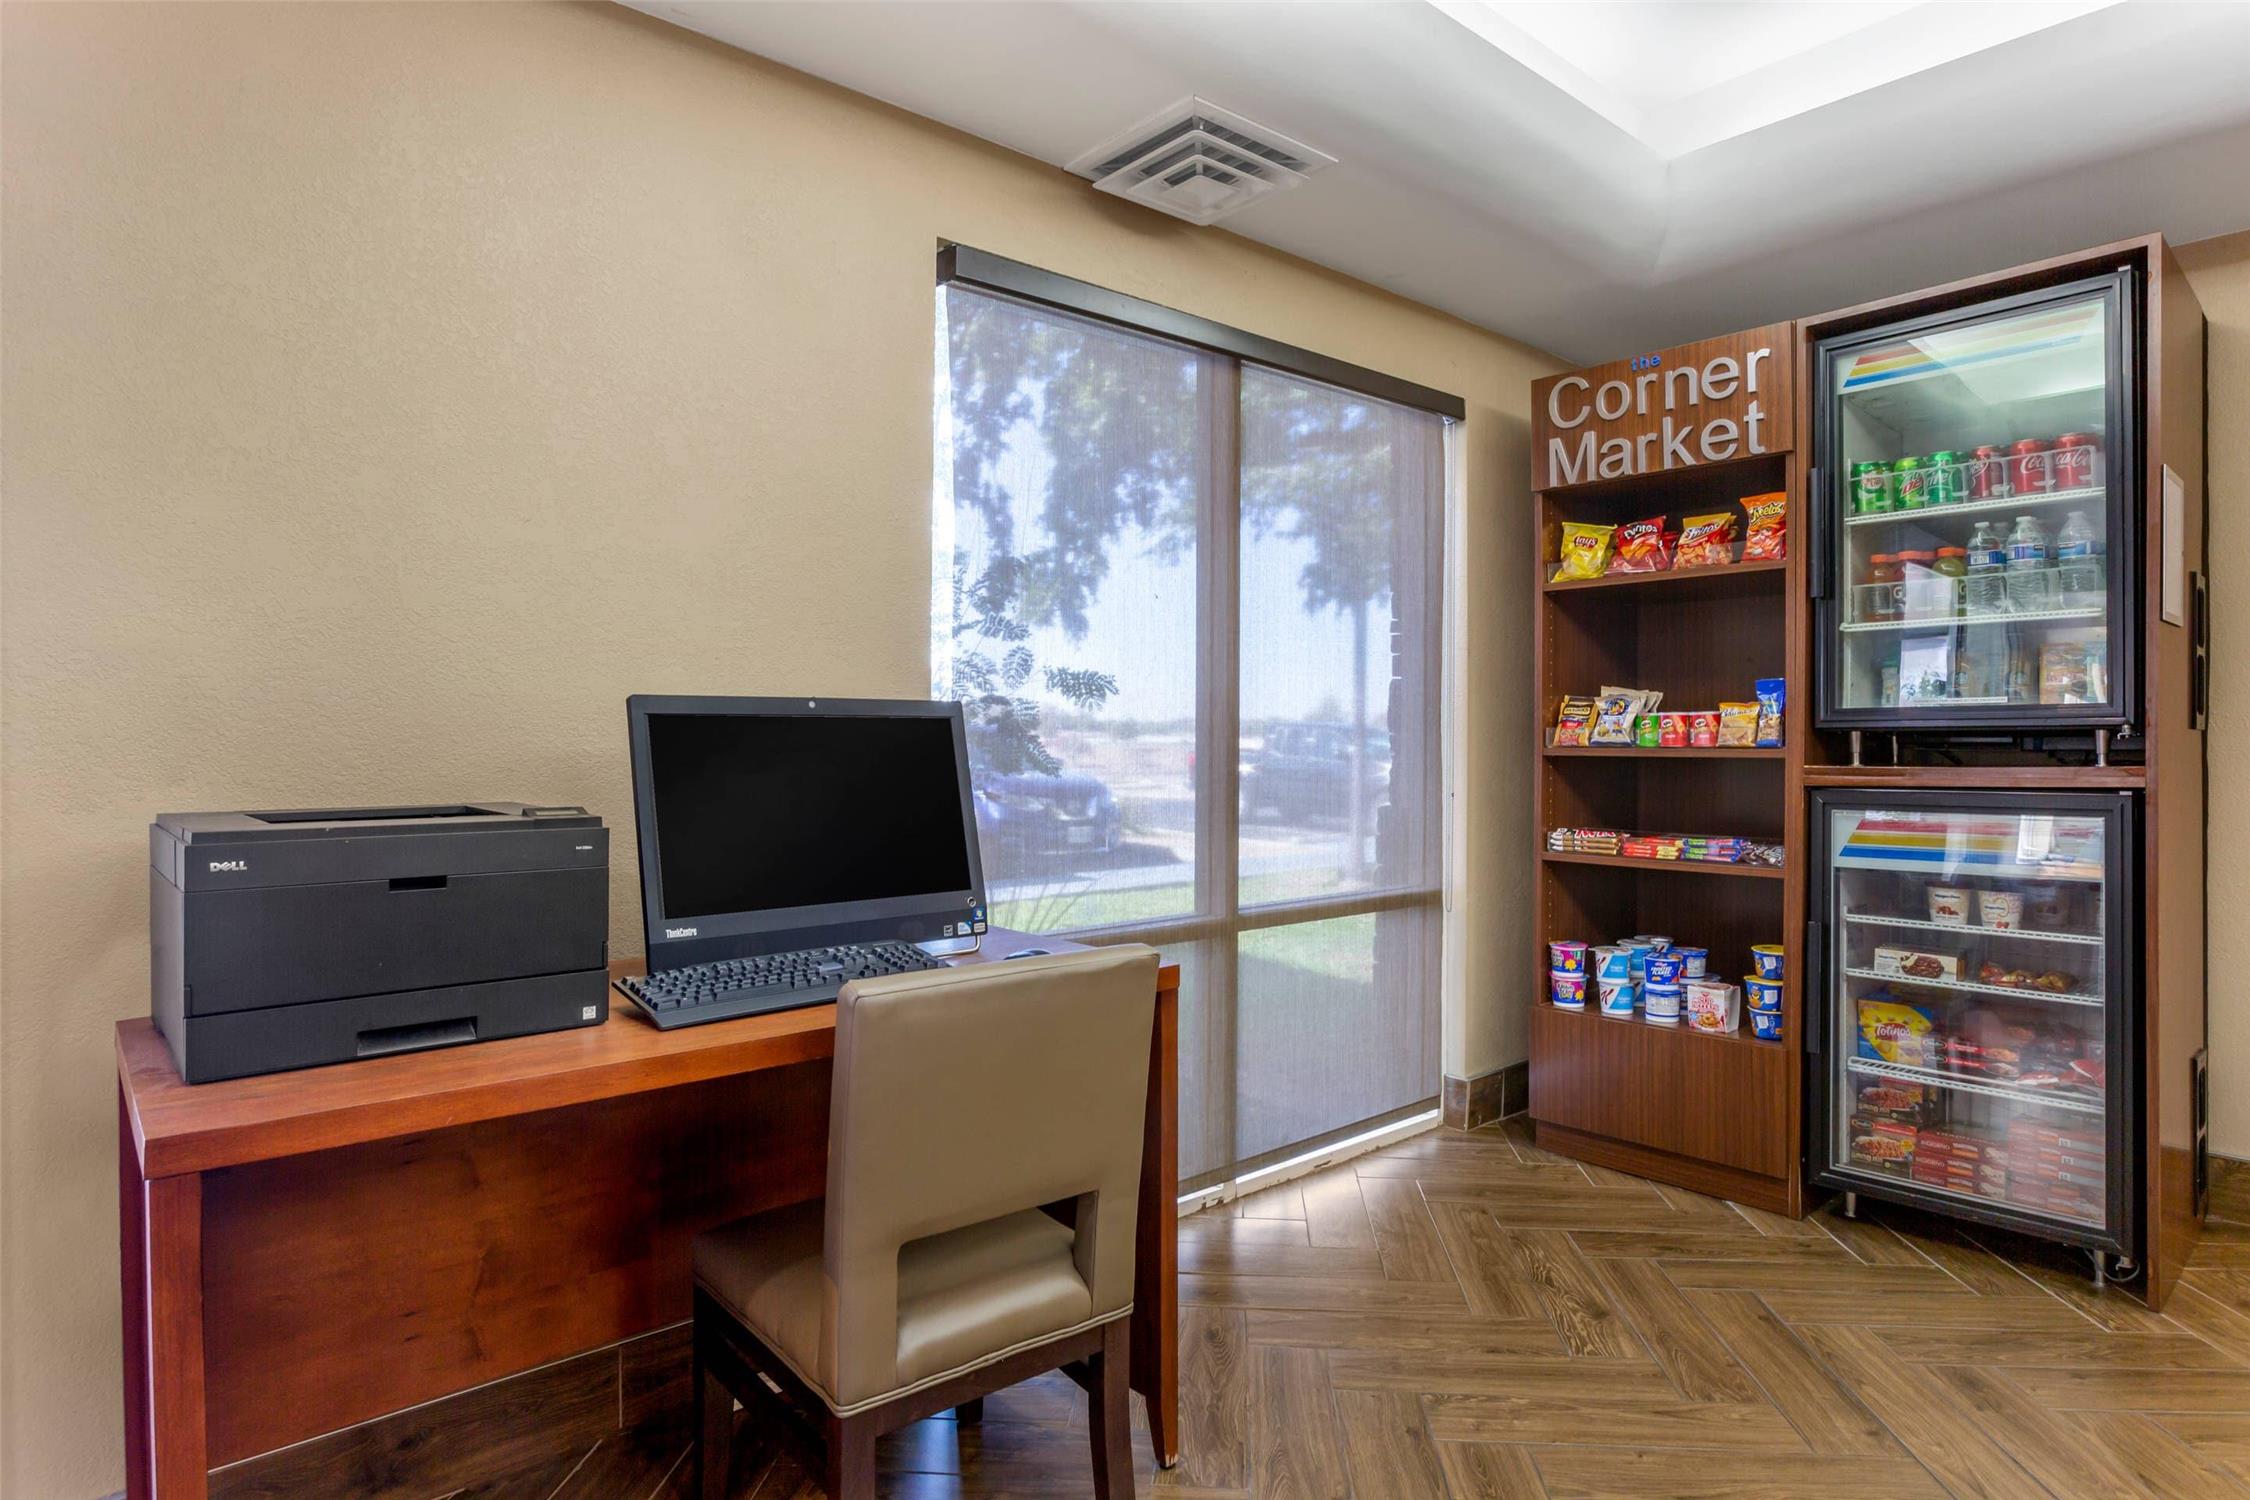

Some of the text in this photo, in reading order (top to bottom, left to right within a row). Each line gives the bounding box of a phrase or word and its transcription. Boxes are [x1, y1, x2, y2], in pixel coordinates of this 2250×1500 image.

[1631, 355, 1662, 372] the
[1548, 348, 1771, 429] Corner
[1549, 400, 1767, 488] Market
[1624, 524, 1658, 540] Doritos
[1575, 536, 1596, 547] Lay's
[209, 860, 248, 873] DELL
[665, 927, 698, 939] ThinkCentre
